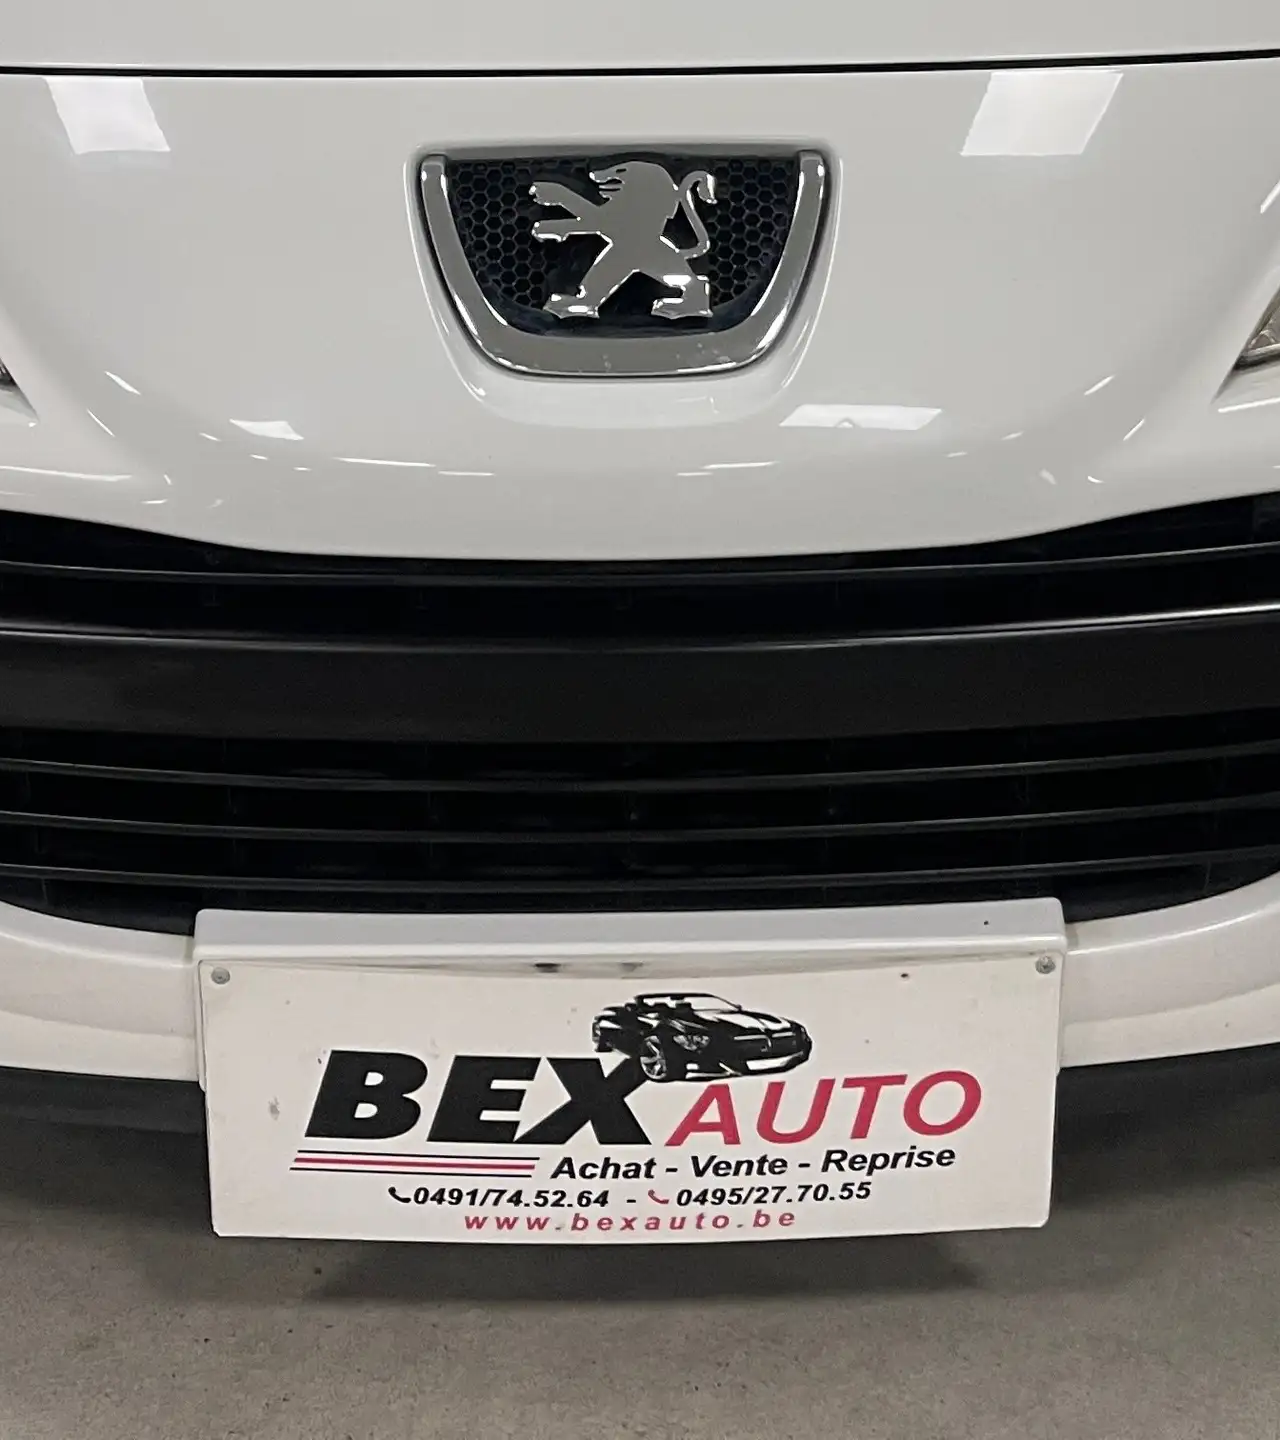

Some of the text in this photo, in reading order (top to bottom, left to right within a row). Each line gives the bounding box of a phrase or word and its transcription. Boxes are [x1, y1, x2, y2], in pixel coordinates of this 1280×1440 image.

[304, 1049, 982, 1147] BEX AUTO
[551, 1156, 657, 1180] Achat
[691, 1154, 788, 1178] Vente
[822, 1145, 956, 1176] Reprise
[413, 1186, 609, 1208] 0491/74.52.64
[676, 1181, 872, 1207] 0495/27.70.55
[464, 1209, 796, 1232] www.bexauto.be
